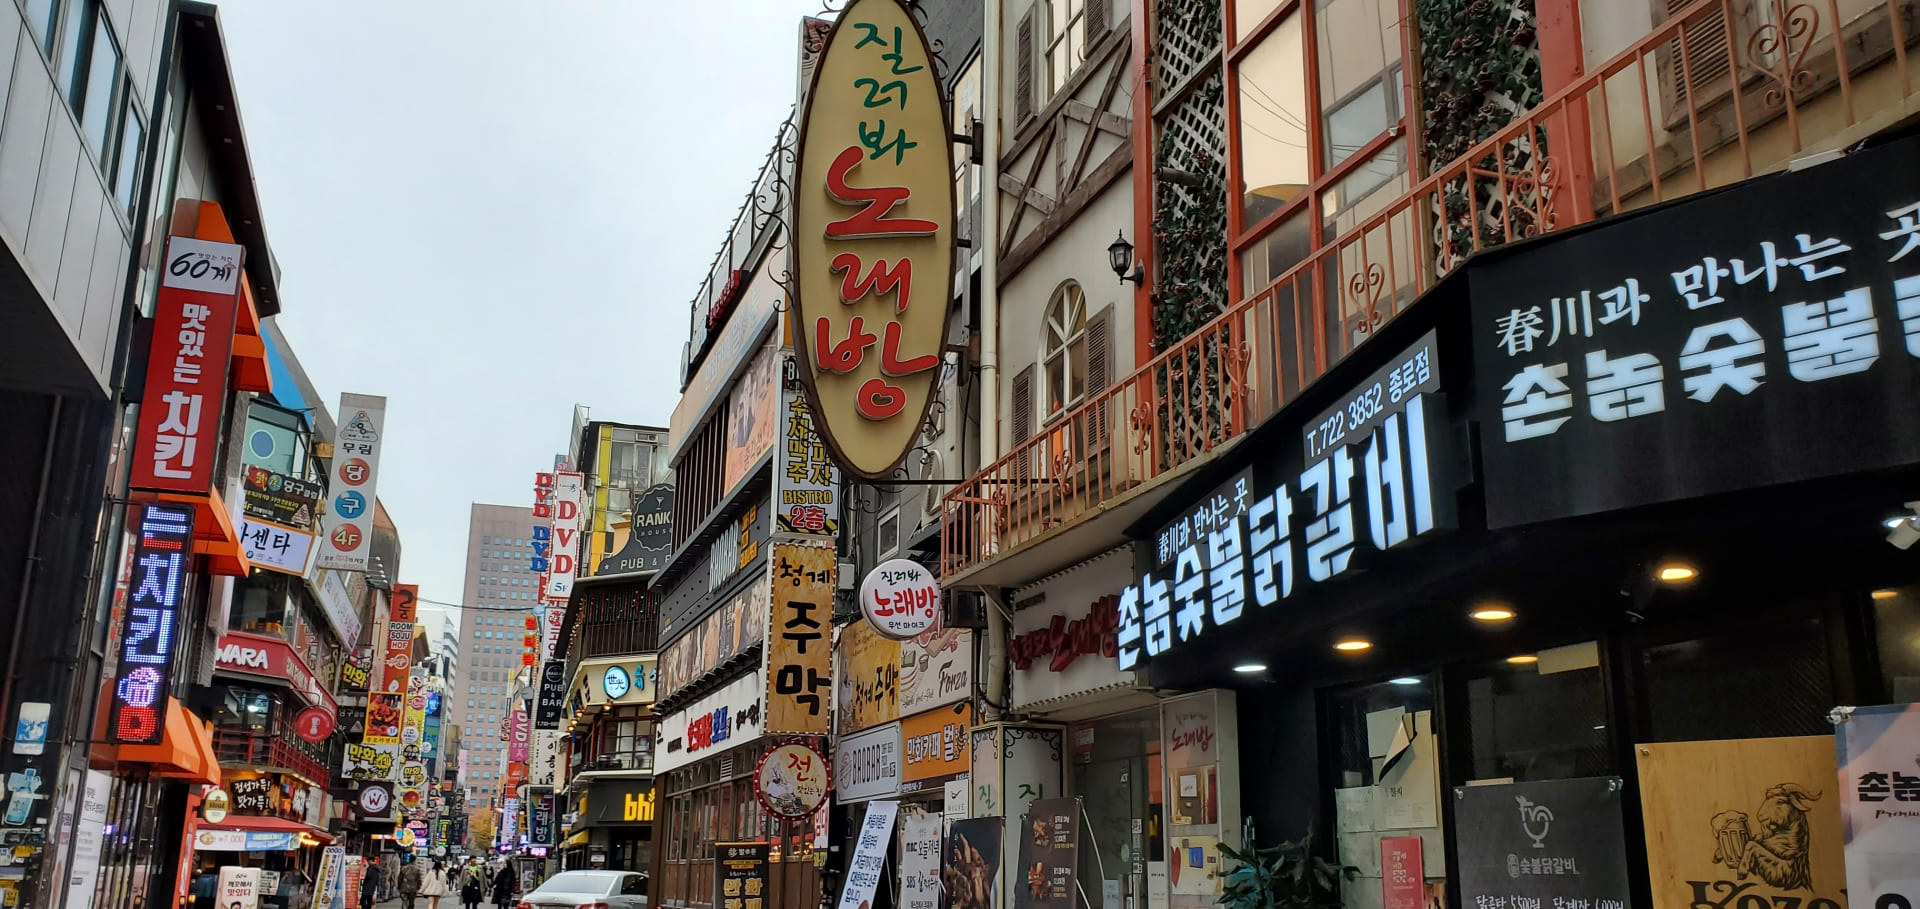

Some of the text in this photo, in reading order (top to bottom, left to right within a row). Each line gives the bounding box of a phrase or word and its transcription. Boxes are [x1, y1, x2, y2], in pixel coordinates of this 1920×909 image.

[853, 23, 924, 166] 질러봐
[170, 252, 232, 282] 60계
[815, 146, 939, 419] 노래방
[1496, 278, 1651, 356] 春川과
[1670, 234, 1852, 311] 만나는
[153, 303, 211, 480] 맛있는 치킨
[1306, 346, 1430, 458] T.722 3852 종로점
[342, 443, 372, 456] 무림
[787, 397, 811, 484] 수제맥주
[533, 473, 552, 517] DVD
[783, 490, 833, 504] BISTRO
[1194, 498, 1230, 540] 만나는
[1234, 477, 1248, 512] 곳
[636, 511, 671, 528] RANK
[791, 505, 825, 531] 2층
[1118, 393, 1434, 671] 촌놈숯불닭갈비
[334, 528, 358, 546] 4F
[530, 526, 550, 572] DVD
[554, 501, 577, 573] DVD
[620, 558, 644, 570] PUB
[780, 557, 830, 587] 청계
[881, 569, 921, 586] 질러봐
[554, 582, 568, 592] 5F
[874, 586, 938, 618] 노래방
[888, 621, 902, 629] 무선
[392, 641, 408, 649] HOF
[776, 601, 831, 716] 주막
[343, 662, 366, 688] 만화
[856, 675, 873, 713] 청계
[875, 663, 899, 712] 주막
[515, 711, 529, 742] DVD
[350, 744, 377, 764] 만화
[853, 744, 880, 784] BAOBAB
[907, 732, 941, 764] 만화카페
[536, 800, 549, 842] 노래방
